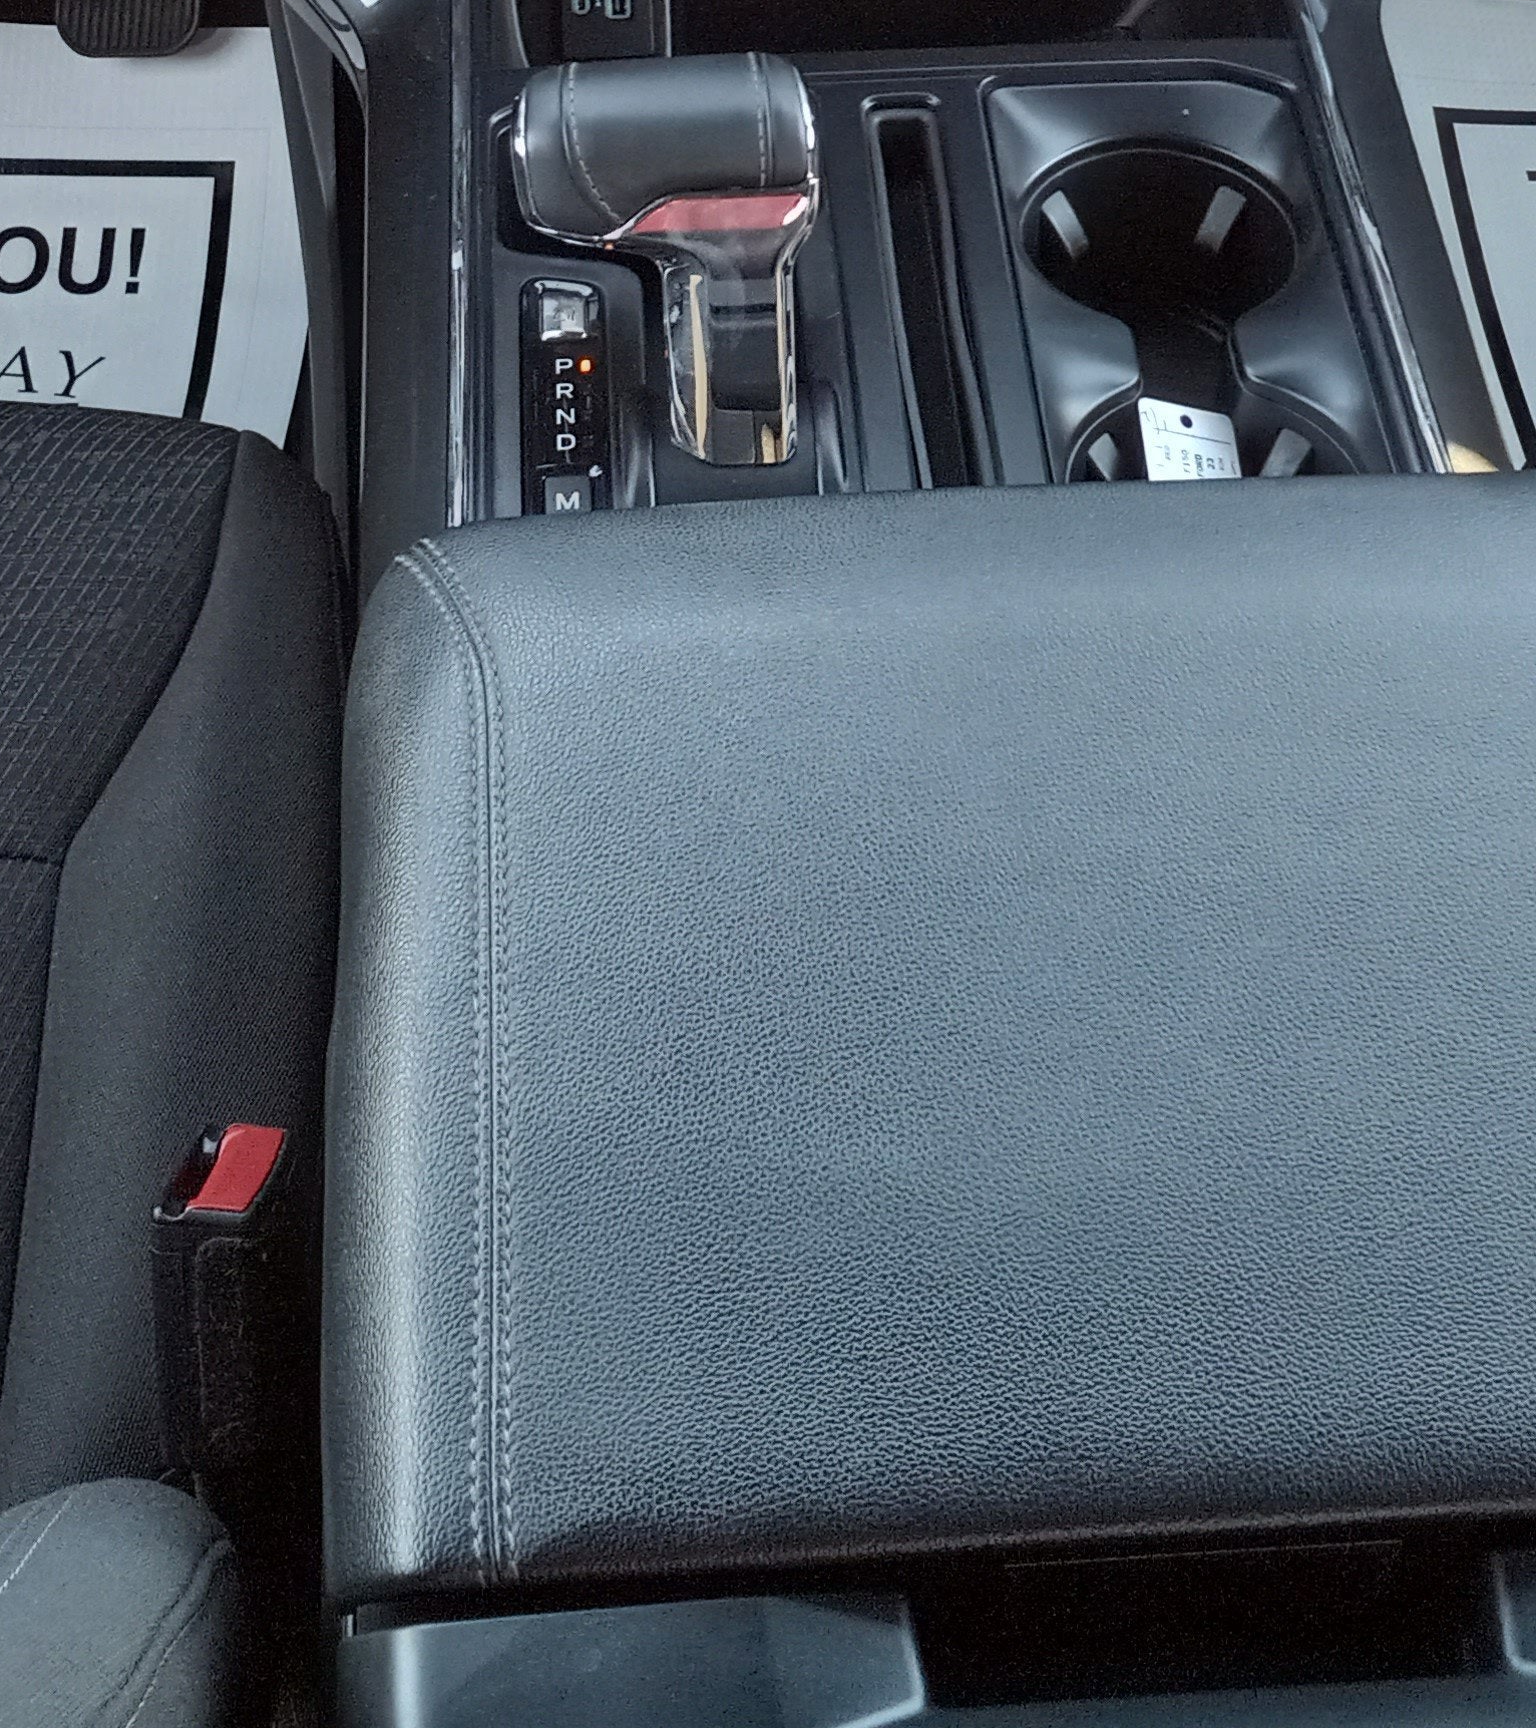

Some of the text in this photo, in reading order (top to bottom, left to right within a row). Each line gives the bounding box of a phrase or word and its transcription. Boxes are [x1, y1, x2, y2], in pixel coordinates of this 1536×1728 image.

[555, 358, 573, 375] P
[555, 382, 575, 399] R
[556, 408, 576, 425] N
[556, 434, 577, 451] D
[556, 491, 581, 510] M
